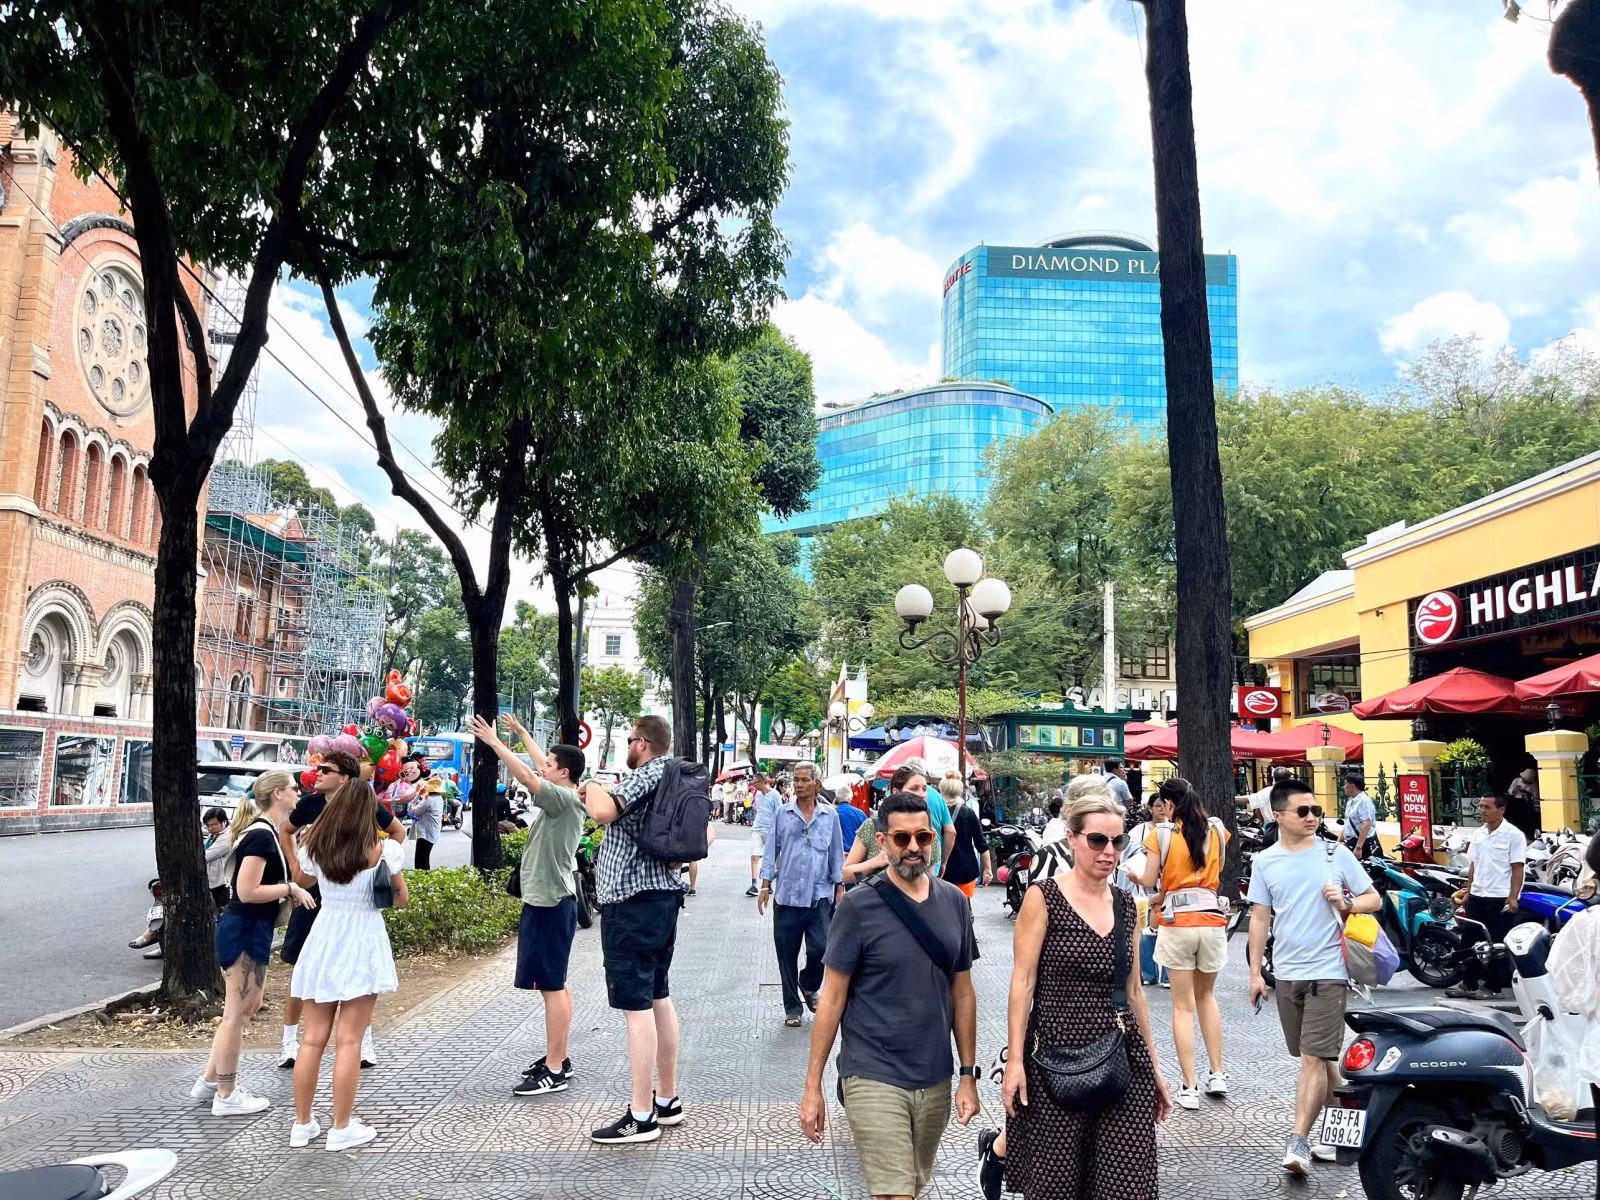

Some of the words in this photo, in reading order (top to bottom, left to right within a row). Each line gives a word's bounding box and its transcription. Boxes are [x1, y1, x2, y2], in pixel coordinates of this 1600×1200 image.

[1012, 254, 1119, 273] DIAMOND
[1403, 793, 1425, 803] NOW
[1403, 803, 1427, 814] OPEN
[1409, 1061, 1467, 1069] SCOOPY
[1330, 1109, 1360, 1128] 59-FA
